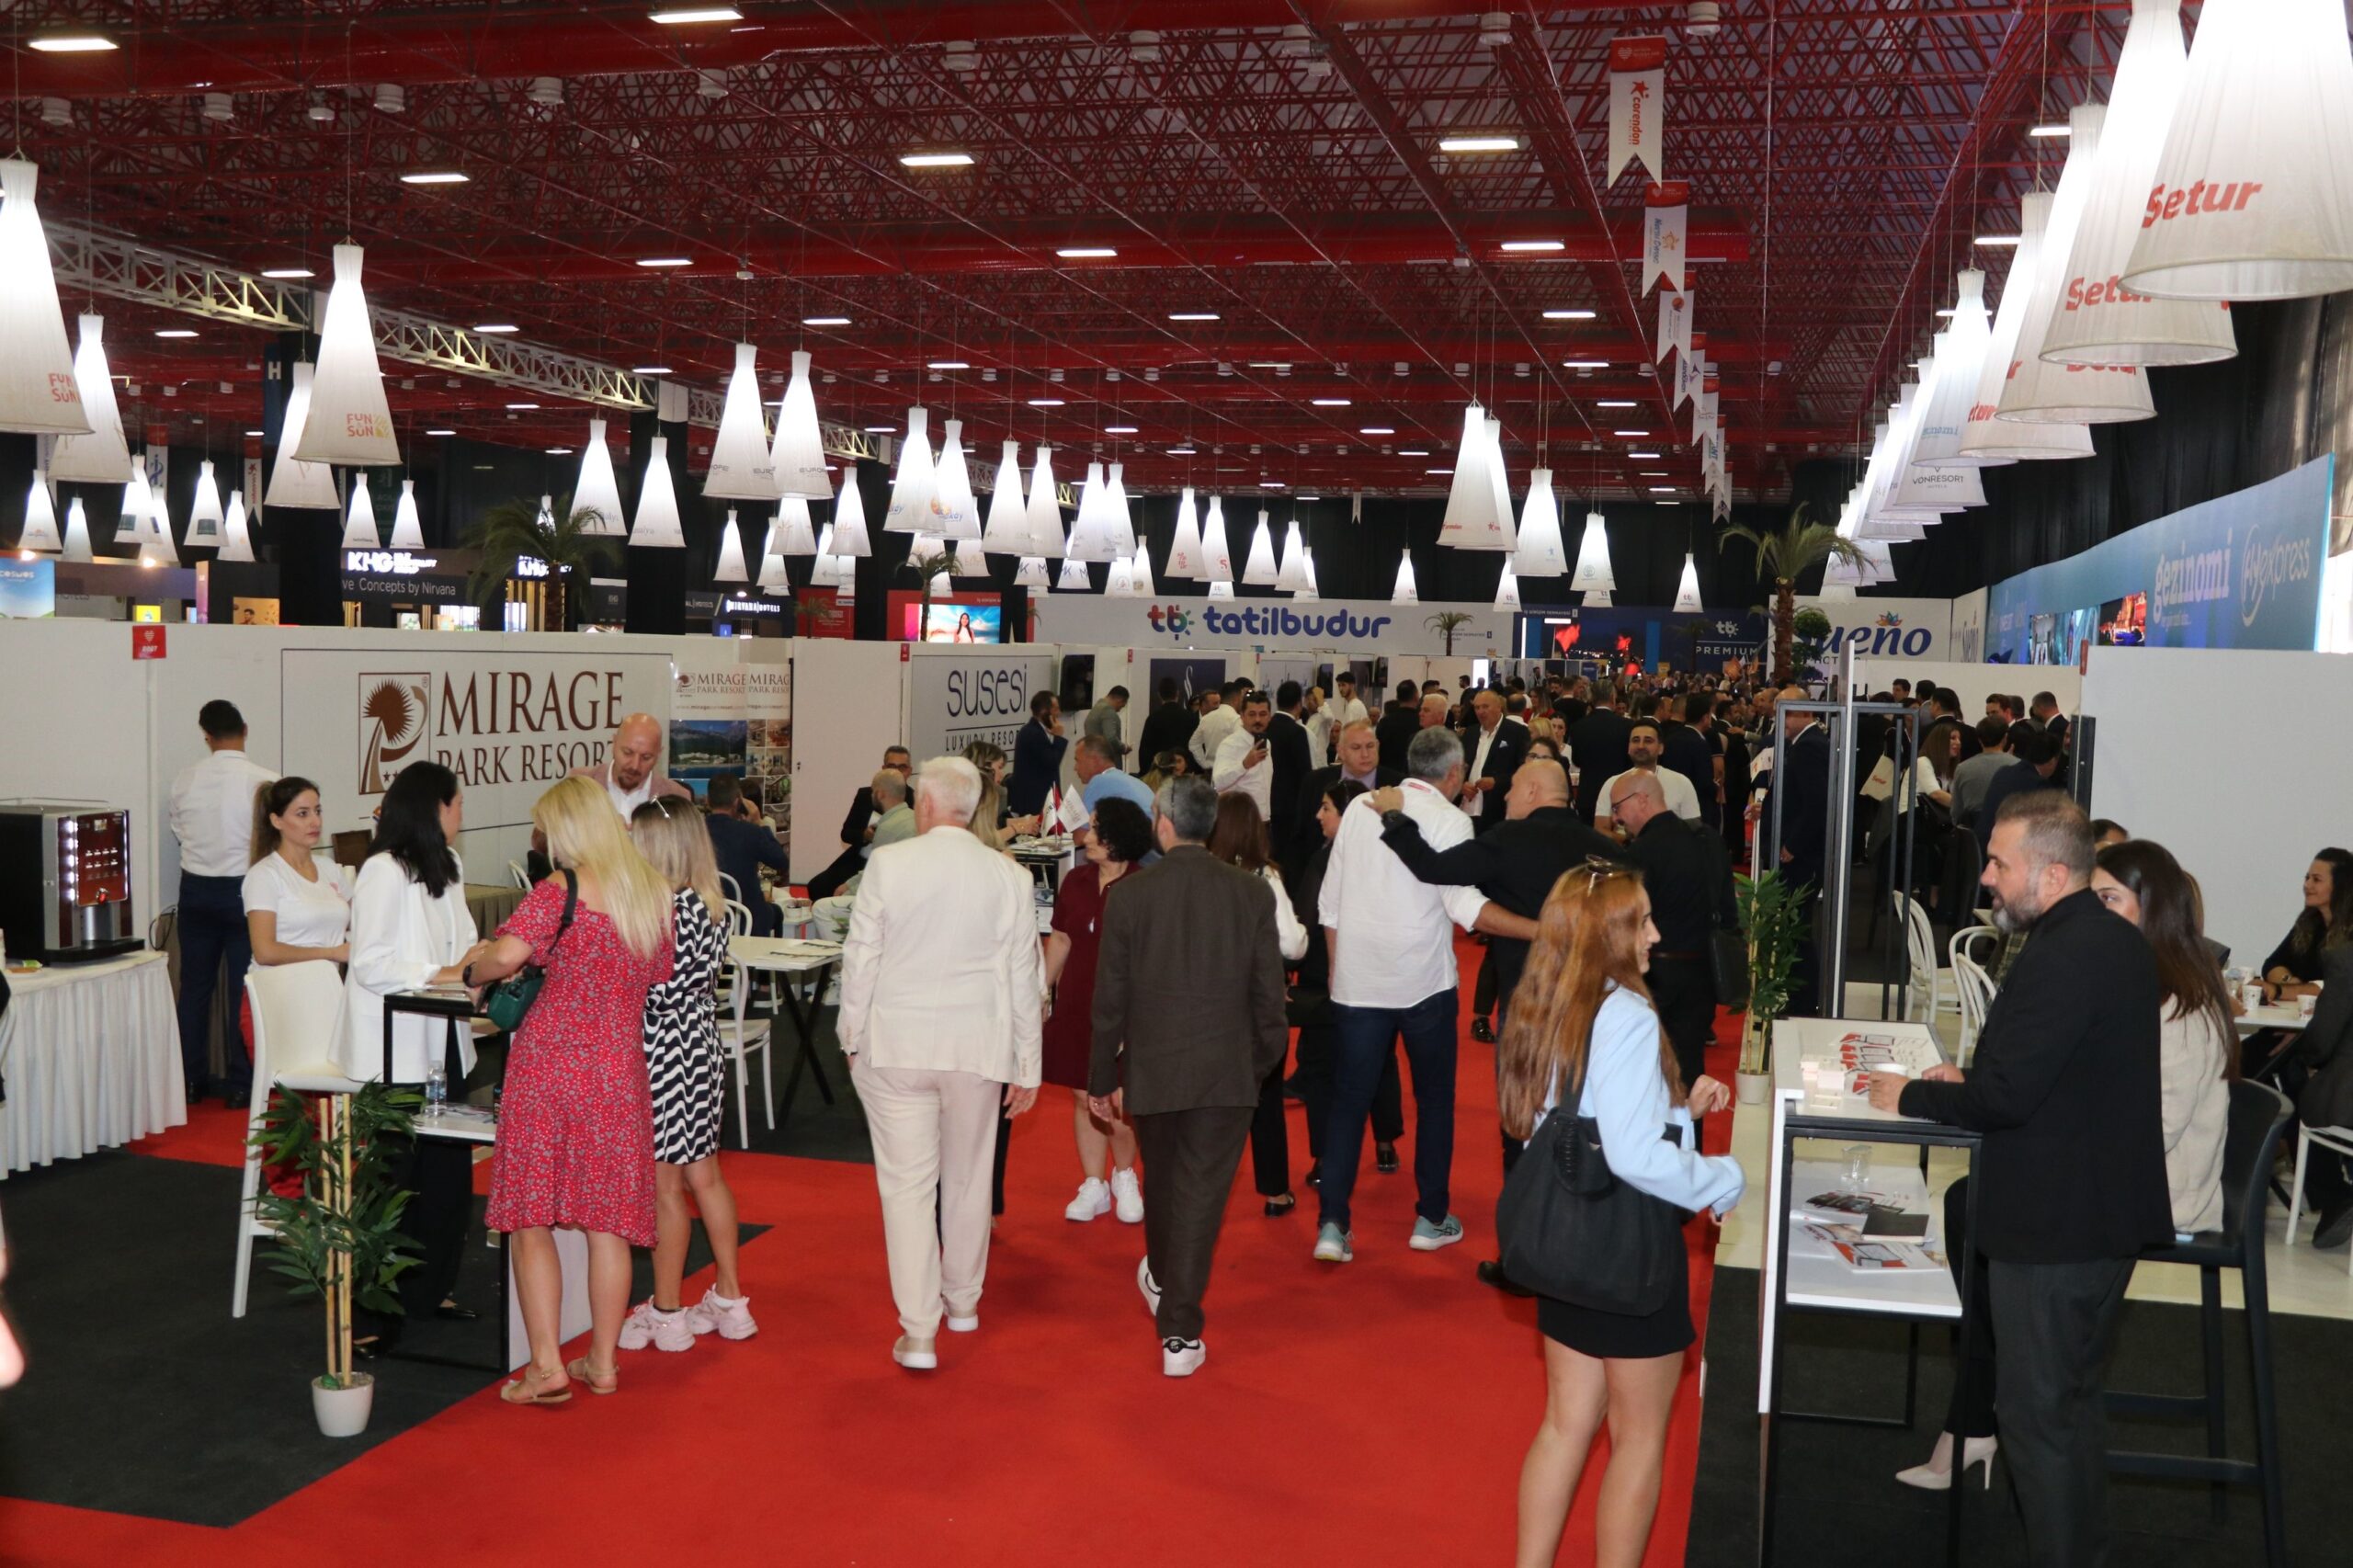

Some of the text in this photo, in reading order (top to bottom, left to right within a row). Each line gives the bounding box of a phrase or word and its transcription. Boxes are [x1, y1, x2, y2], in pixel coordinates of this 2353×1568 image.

[1632, 97, 1643, 145] corendon
[2141, 178, 2263, 229] Setur
[2065, 275, 2153, 311] Set
[267, 361, 281, 381] H
[347, 413, 373, 425] FUN
[347, 425, 374, 437] SUN
[347, 551, 393, 573] KHG
[2153, 527, 2233, 625] gezinomi
[342, 578, 457, 597] ve Concepts by Nirvana
[1202, 605, 1392, 639] tatilbudur
[1696, 645, 1758, 656] PREMIUM
[1792, 625, 1932, 656] ueno
[697, 673, 746, 686] MIRAGE
[697, 686, 719, 694] PARK
[749, 673, 790, 686] MIRAG
[947, 664, 1028, 718] susesi
[436, 670, 624, 737] MIRAGE
[991, 730, 1020, 746] RESO
[520, 741, 615, 782] RESOR
